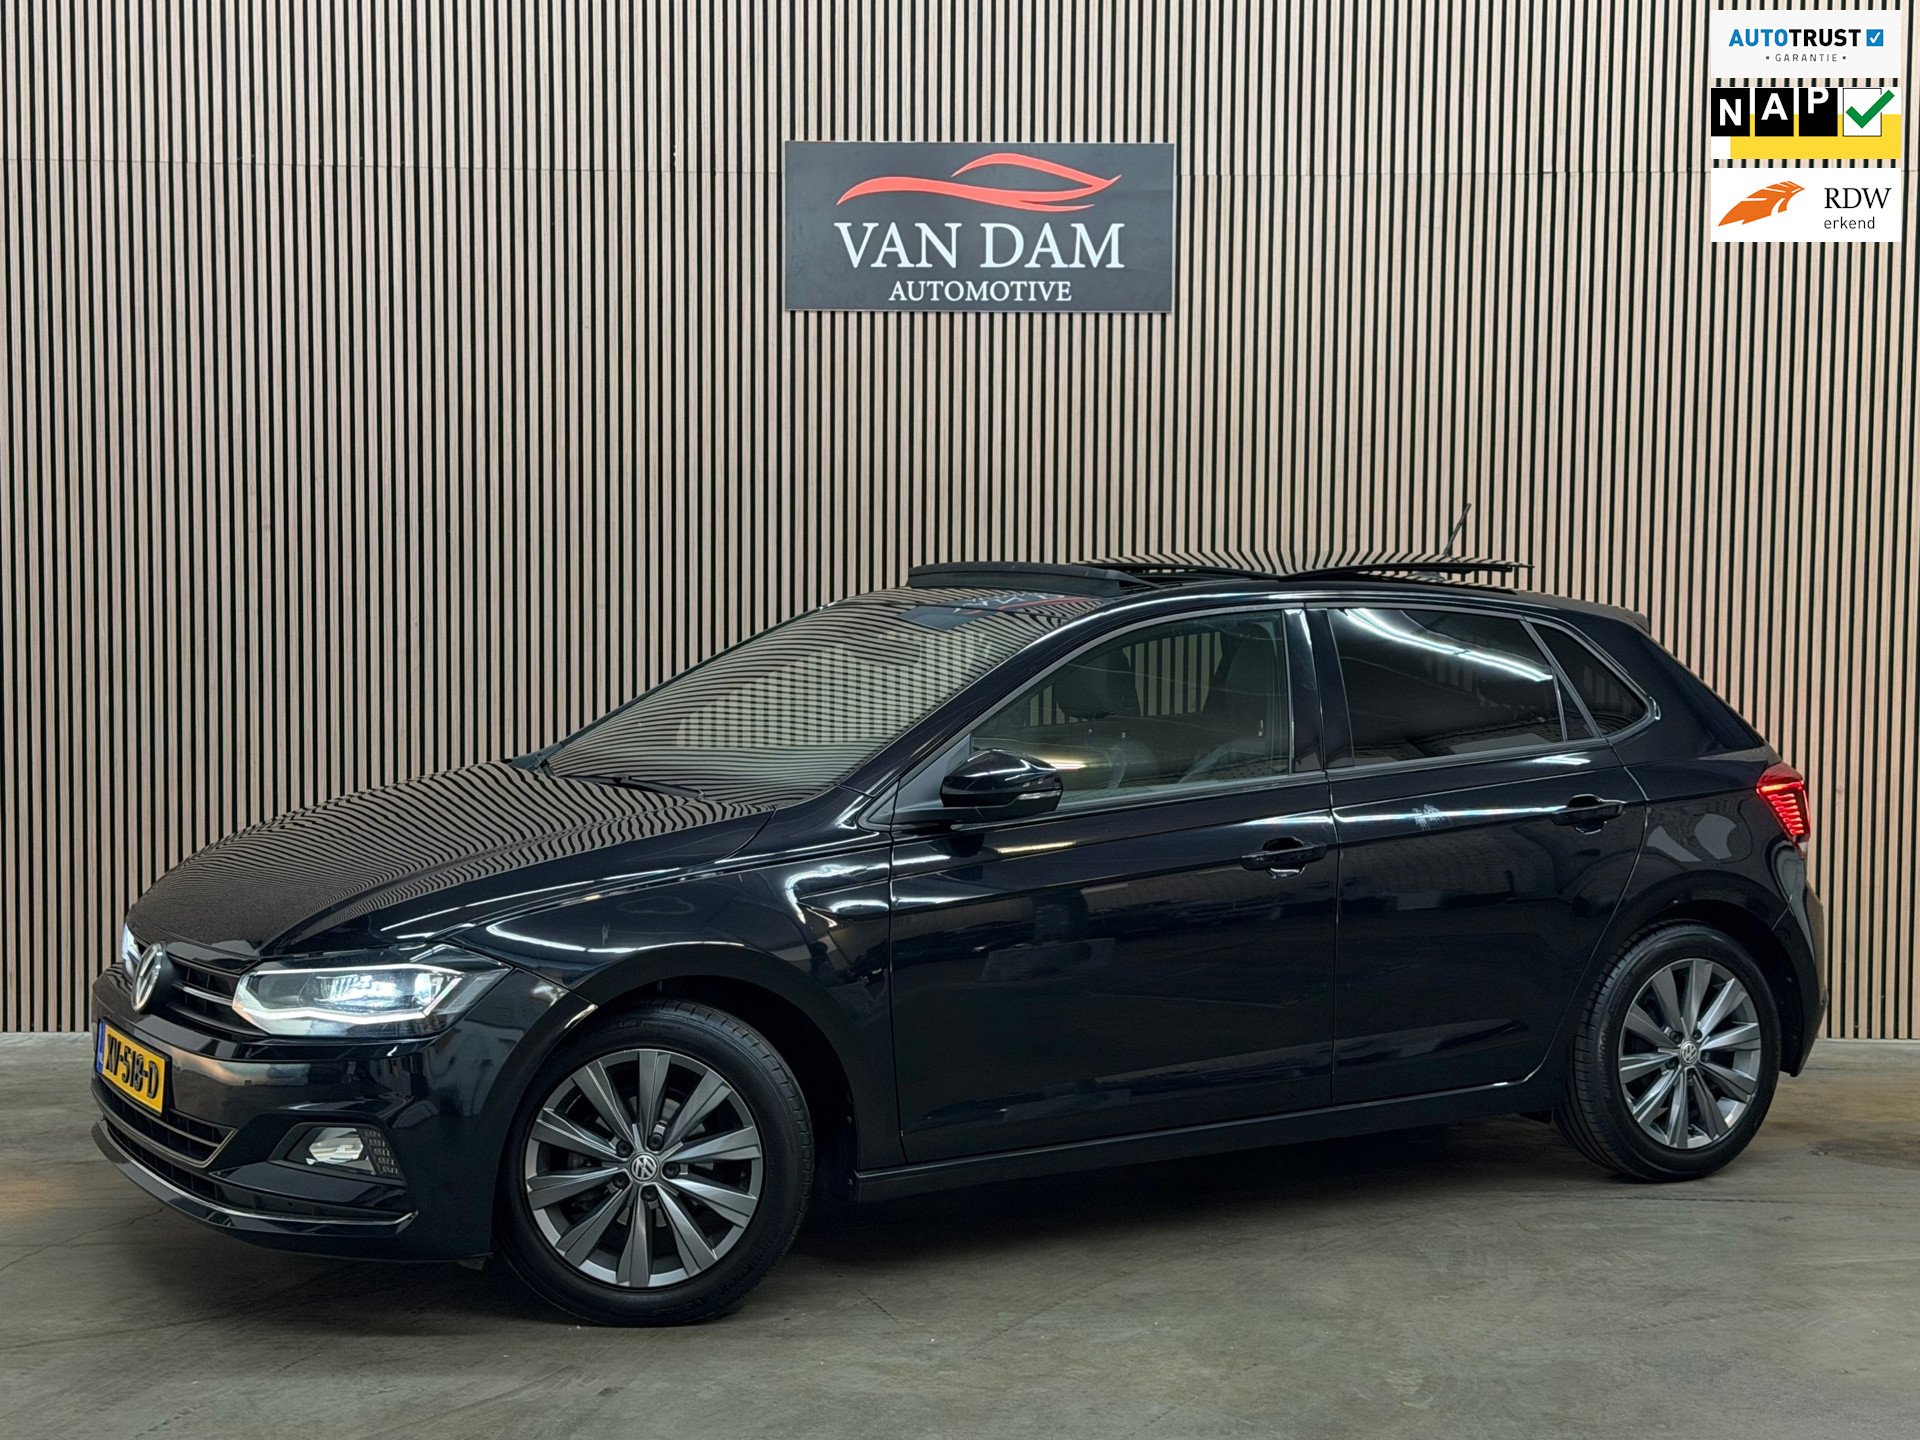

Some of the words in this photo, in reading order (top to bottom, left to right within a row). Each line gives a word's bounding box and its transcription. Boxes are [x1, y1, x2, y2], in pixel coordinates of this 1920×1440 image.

[833, 221, 963, 269] VAN
[979, 222, 1126, 269] DAM
[888, 280, 1073, 302] AUTOMOTIVE
